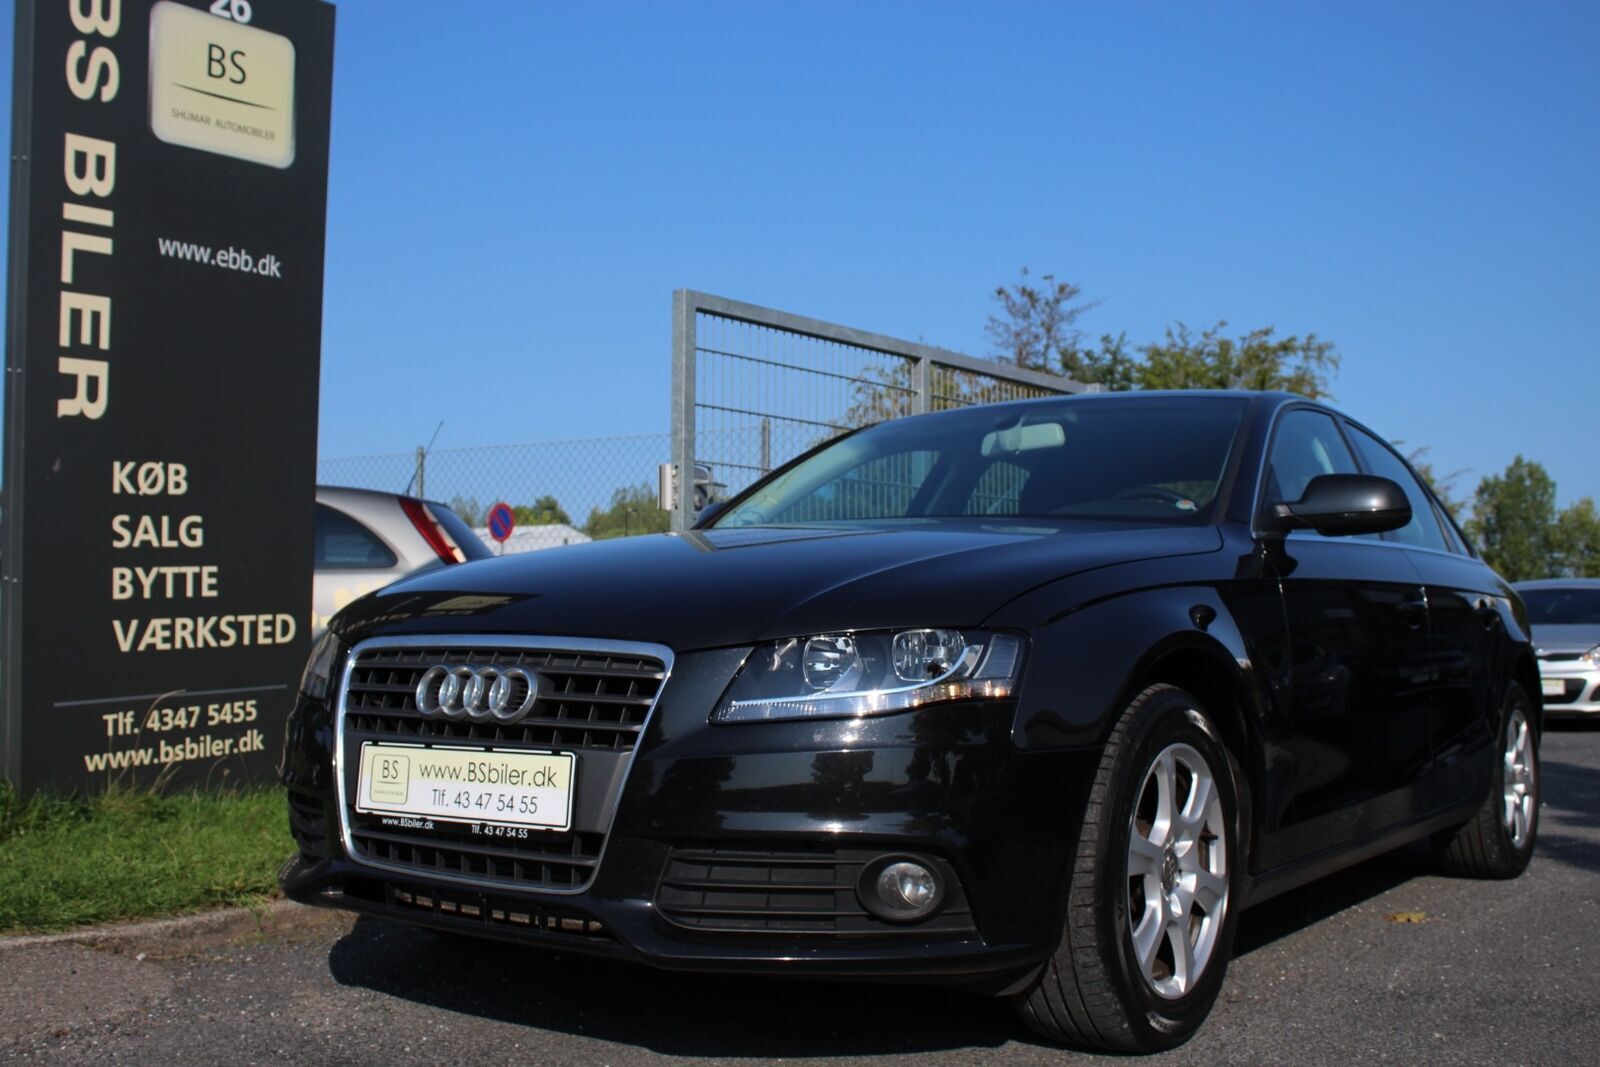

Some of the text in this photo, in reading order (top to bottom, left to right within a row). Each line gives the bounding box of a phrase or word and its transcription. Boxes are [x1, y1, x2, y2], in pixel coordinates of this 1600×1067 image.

[208, 42, 247, 85] BS
[171, 107, 276, 141] SHUMAR AUTOMOBILER
[57, 0, 121, 420] BS BILER
[158, 237, 282, 278] www.ebb.dk
[112, 460, 189, 496] KØB
[112, 514, 204, 548] SALG
[112, 566, 219, 600] BYTTE
[112, 613, 297, 652] VÆRKSTED
[102, 700, 258, 737] Tlf. 4347 5455
[84, 729, 265, 773] www.bsbiler.dk
[381, 759, 400, 780] BS
[419, 761, 558, 788] www.BSbiler.dk
[432, 788, 538, 815] Tlf. 43 47 54 55
[381, 816, 435, 831] www.BSbiler.dk
[484, 825, 494, 836] 43
[495, 826, 506, 837] 47
[506, 827, 517, 838] 54
[518, 828, 529, 839] 55
